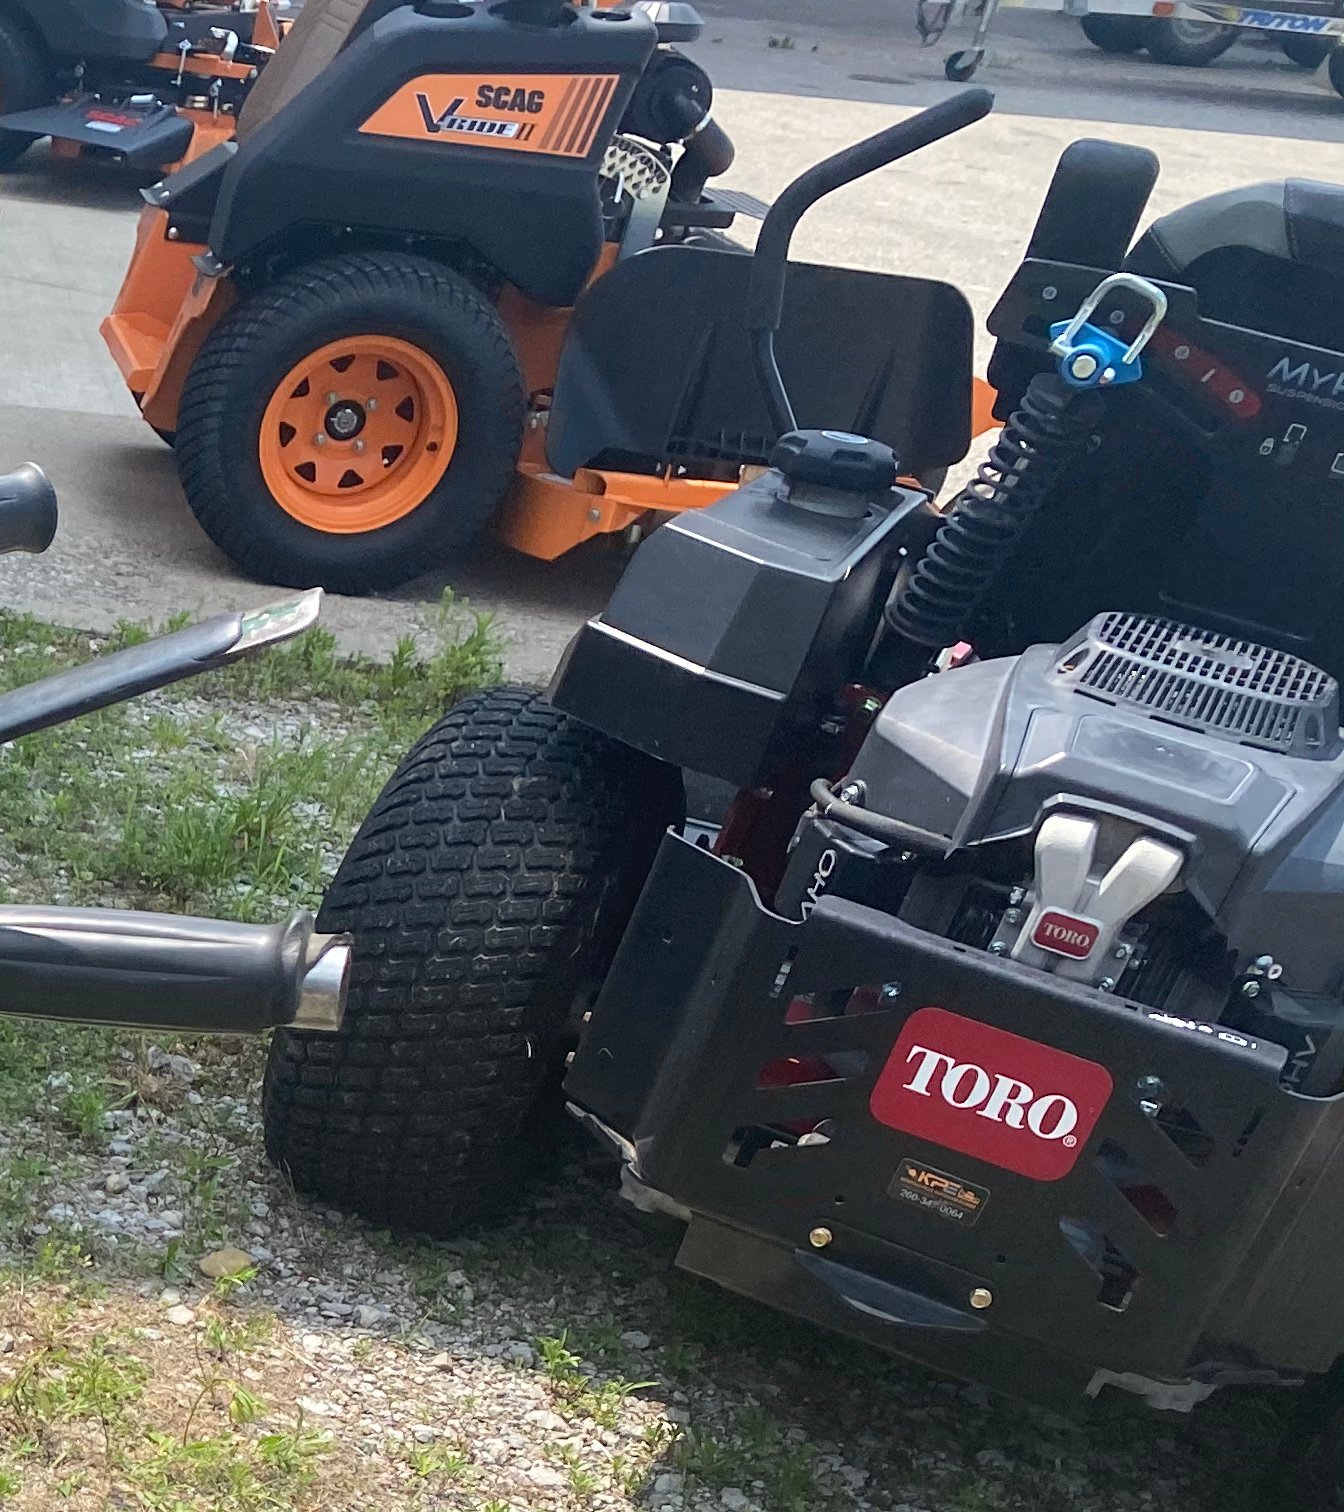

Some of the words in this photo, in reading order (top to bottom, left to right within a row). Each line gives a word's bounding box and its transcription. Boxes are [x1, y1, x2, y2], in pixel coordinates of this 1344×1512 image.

[475, 84, 545, 114] SCAG
[1044, 922, 1090, 947] TORO
[902, 1044, 1078, 1141] TORO
